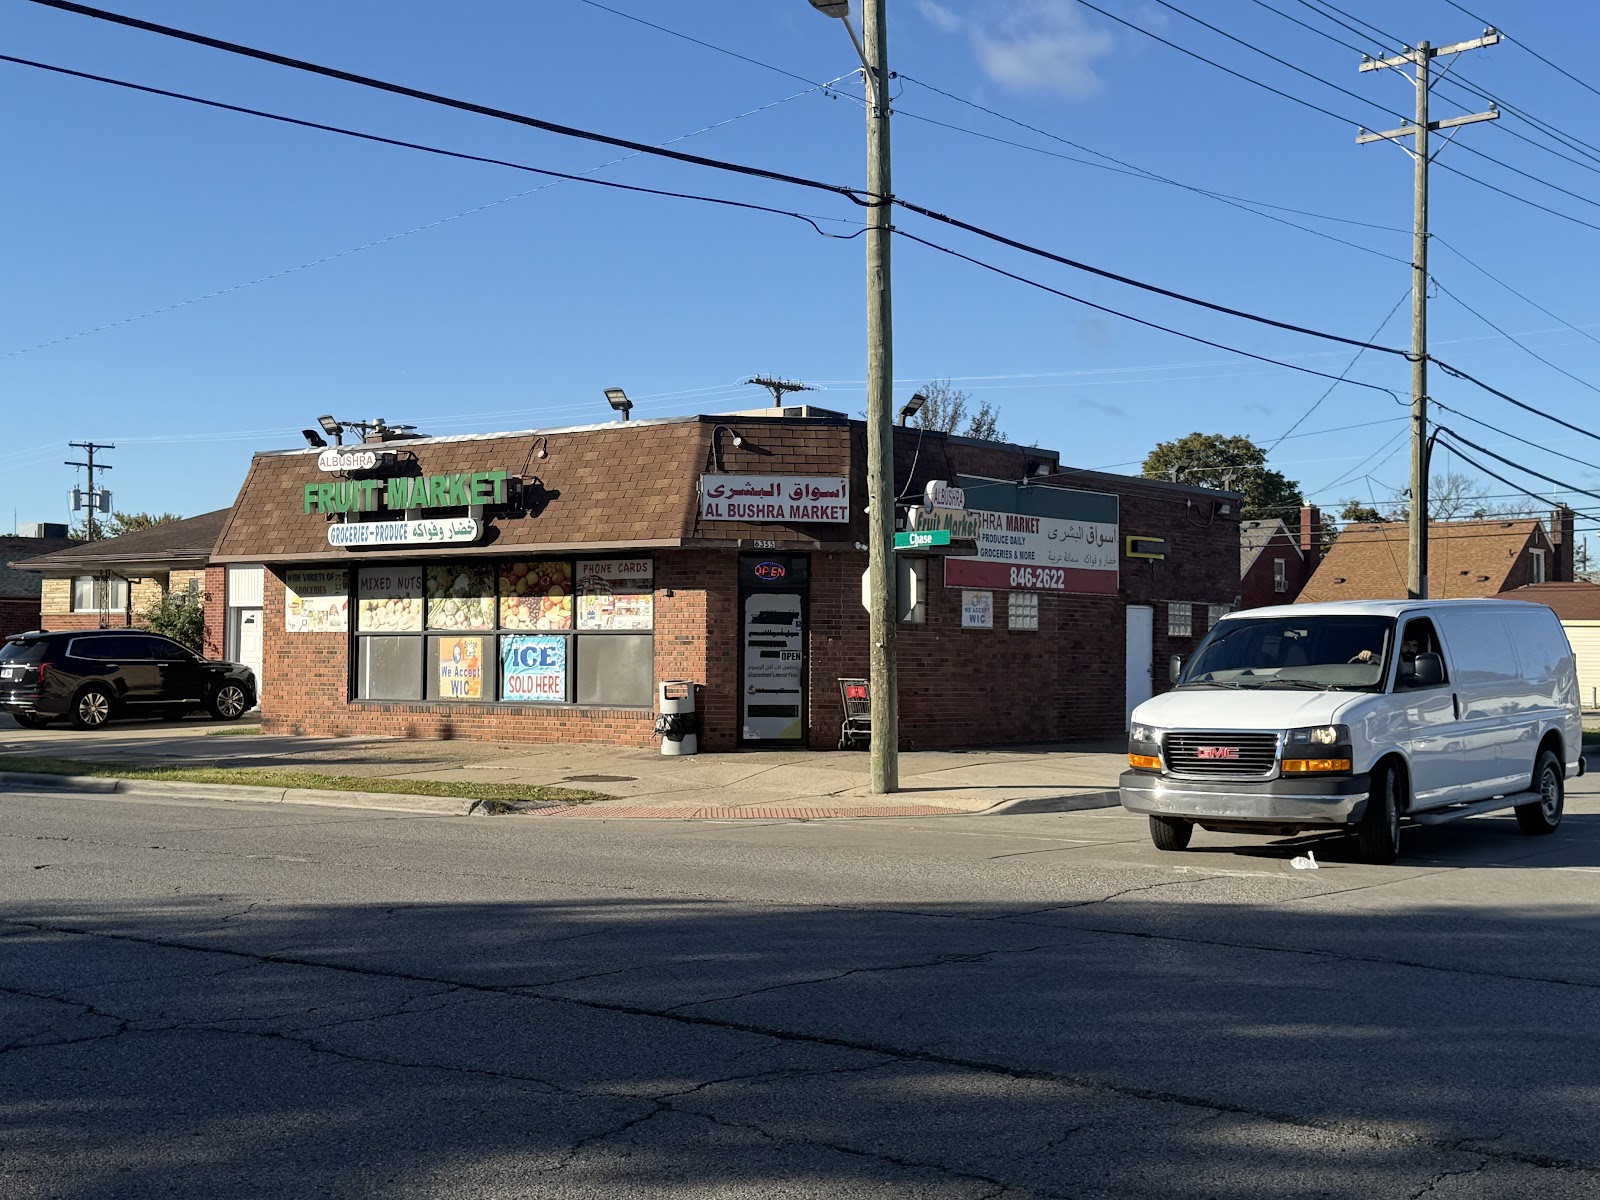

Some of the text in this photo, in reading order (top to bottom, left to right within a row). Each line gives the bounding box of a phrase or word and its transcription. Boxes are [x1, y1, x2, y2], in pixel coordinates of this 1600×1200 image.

[319, 455, 374, 467] ALBUSHRA
[304, 471, 508, 514] FRUIT MARKET
[706, 480, 847, 501] أسواق البشرى
[705, 503, 848, 520] AL BUSHRA MARKET
[448, 520, 475, 539] خضار
[917, 511, 977, 537] Fruit Market
[1006, 514, 1040, 534] MARKET
[909, 533, 933, 545] Chase
[982, 533, 1009, 544] PRODUCE
[1010, 536, 1026, 545] DAILY
[1048, 525, 1084, 542] البشرى
[980, 548, 1036, 560] GROCERIES & MORE
[583, 562, 648, 574] PHONE CARDS
[755, 565, 785, 577] OPEN
[303, 572, 325, 582] VARIETY
[327, 572, 335, 581] OF
[360, 577, 392, 590] MIXED
[397, 576, 422, 590] NUTS
[1009, 566, 1065, 589] 846-2622
[294, 585, 327, 595] GROCERIES
[969, 614, 986, 624] WIC
[512, 643, 557, 668] ICE
[781, 652, 801, 661] OPEN
[441, 666, 480, 680] We Accept
[451, 680, 470, 696] WIC
[508, 675, 560, 694] SOLD HERE
[1197, 746, 1240, 759] GMC
